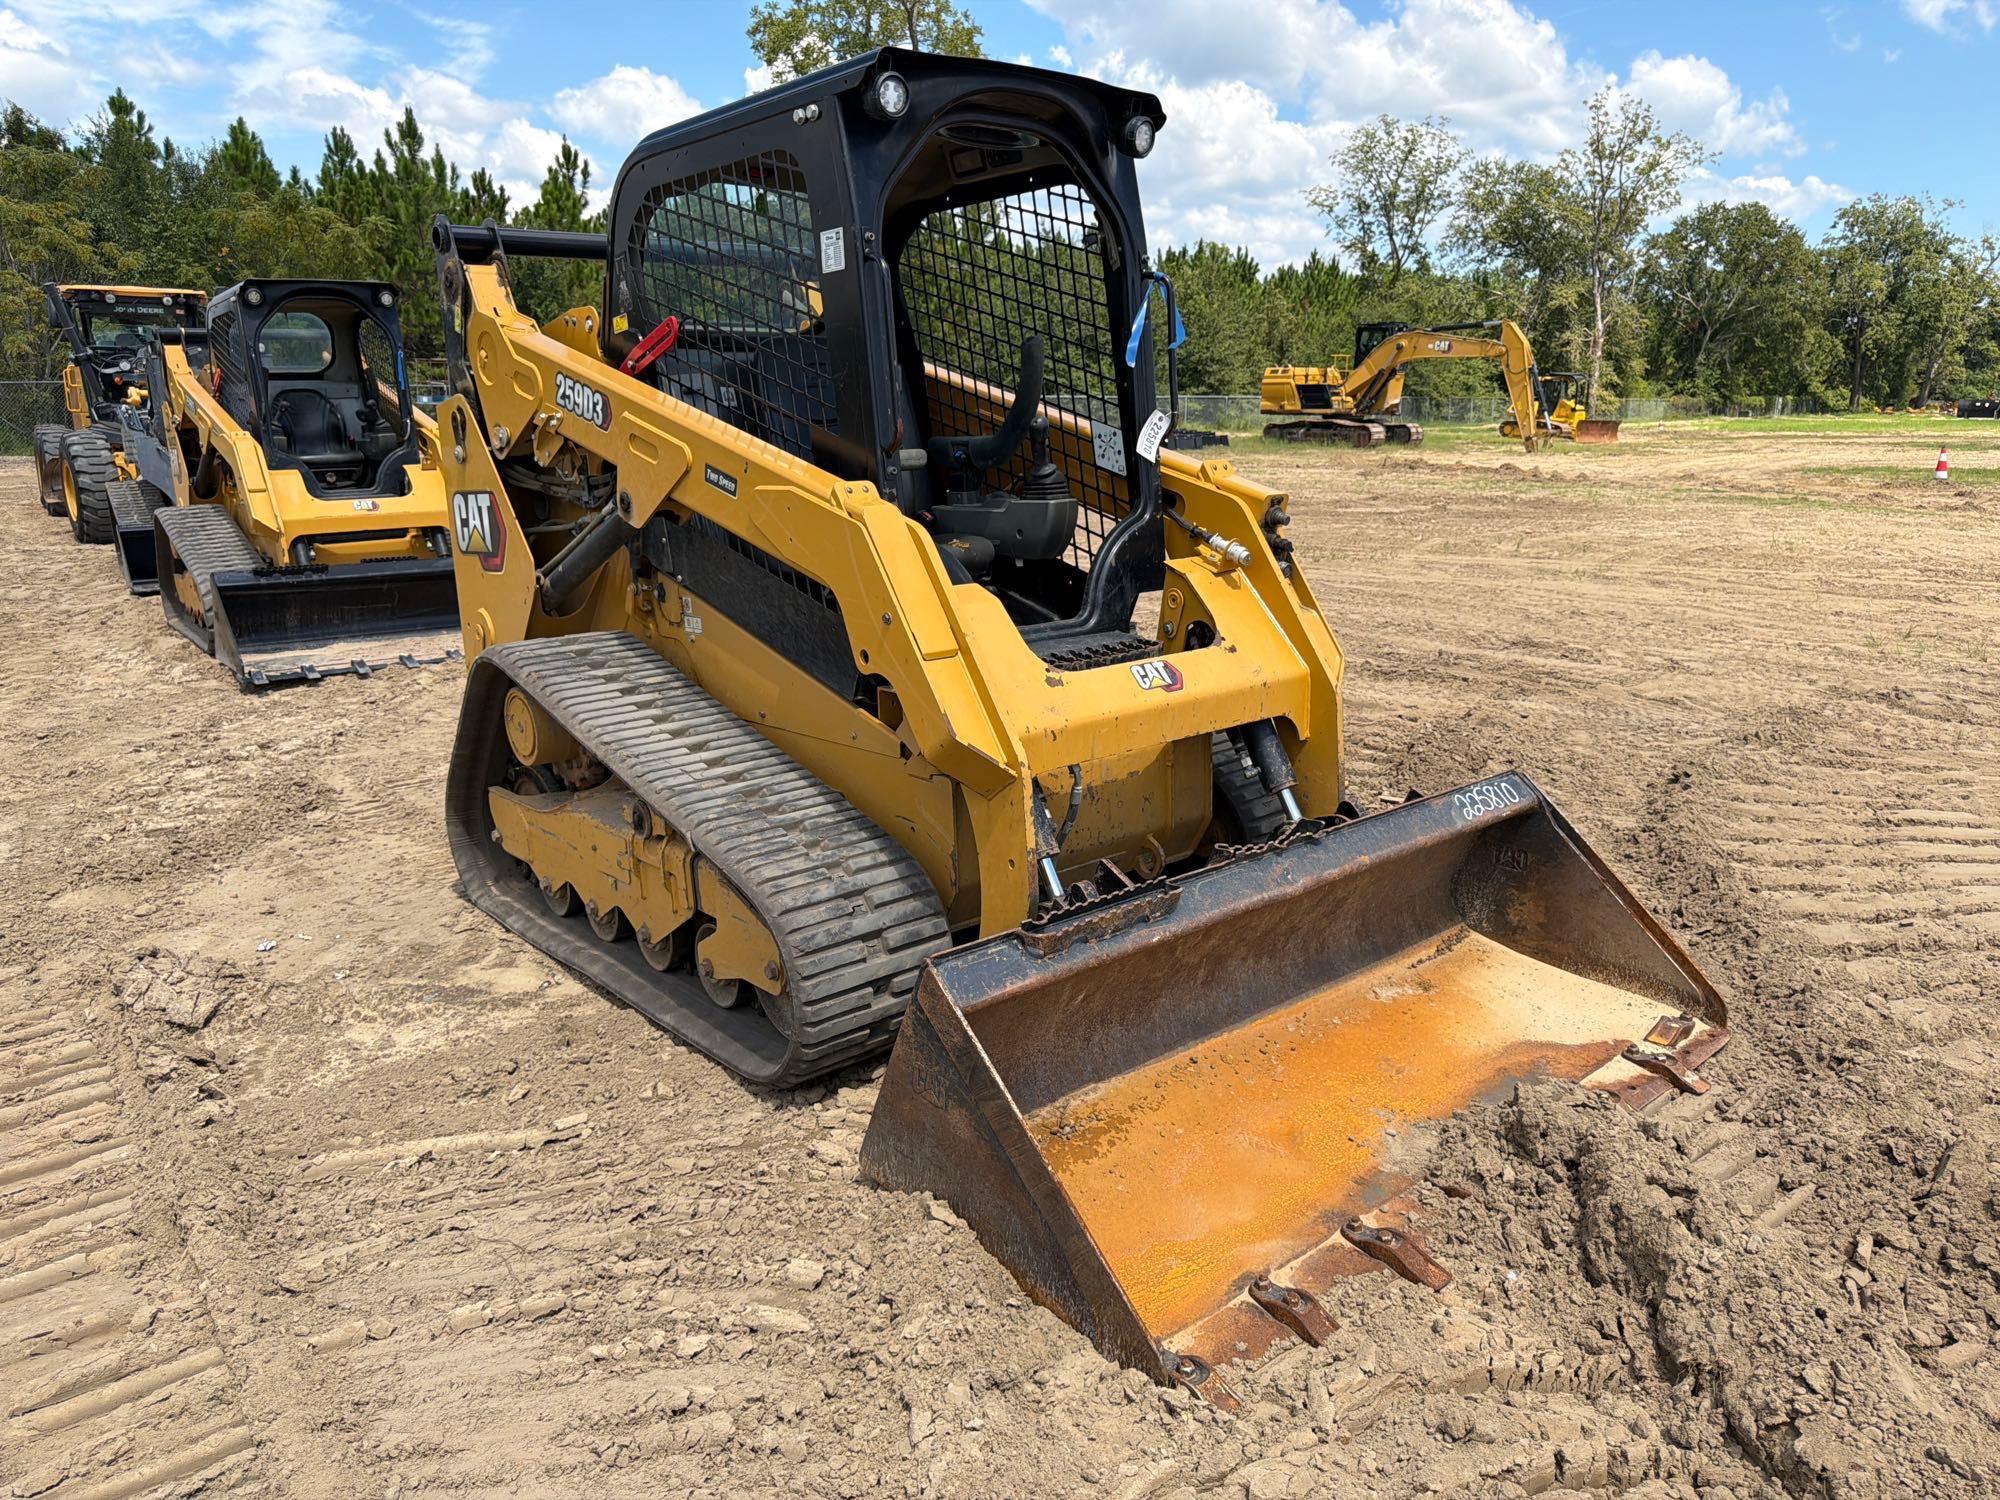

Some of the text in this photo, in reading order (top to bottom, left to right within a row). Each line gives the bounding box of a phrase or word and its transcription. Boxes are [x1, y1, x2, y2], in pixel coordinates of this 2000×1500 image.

[137, 306, 165, 314] DEERE
[1434, 340, 1451, 352] CAT
[555, 373, 603, 427] 259D3
[1143, 422, 1163, 455] 225810
[352, 499, 373, 511] CAT
[453, 493, 493, 553] CAT
[1130, 661, 1173, 690] CAT
[1454, 782, 1520, 820] 225810
